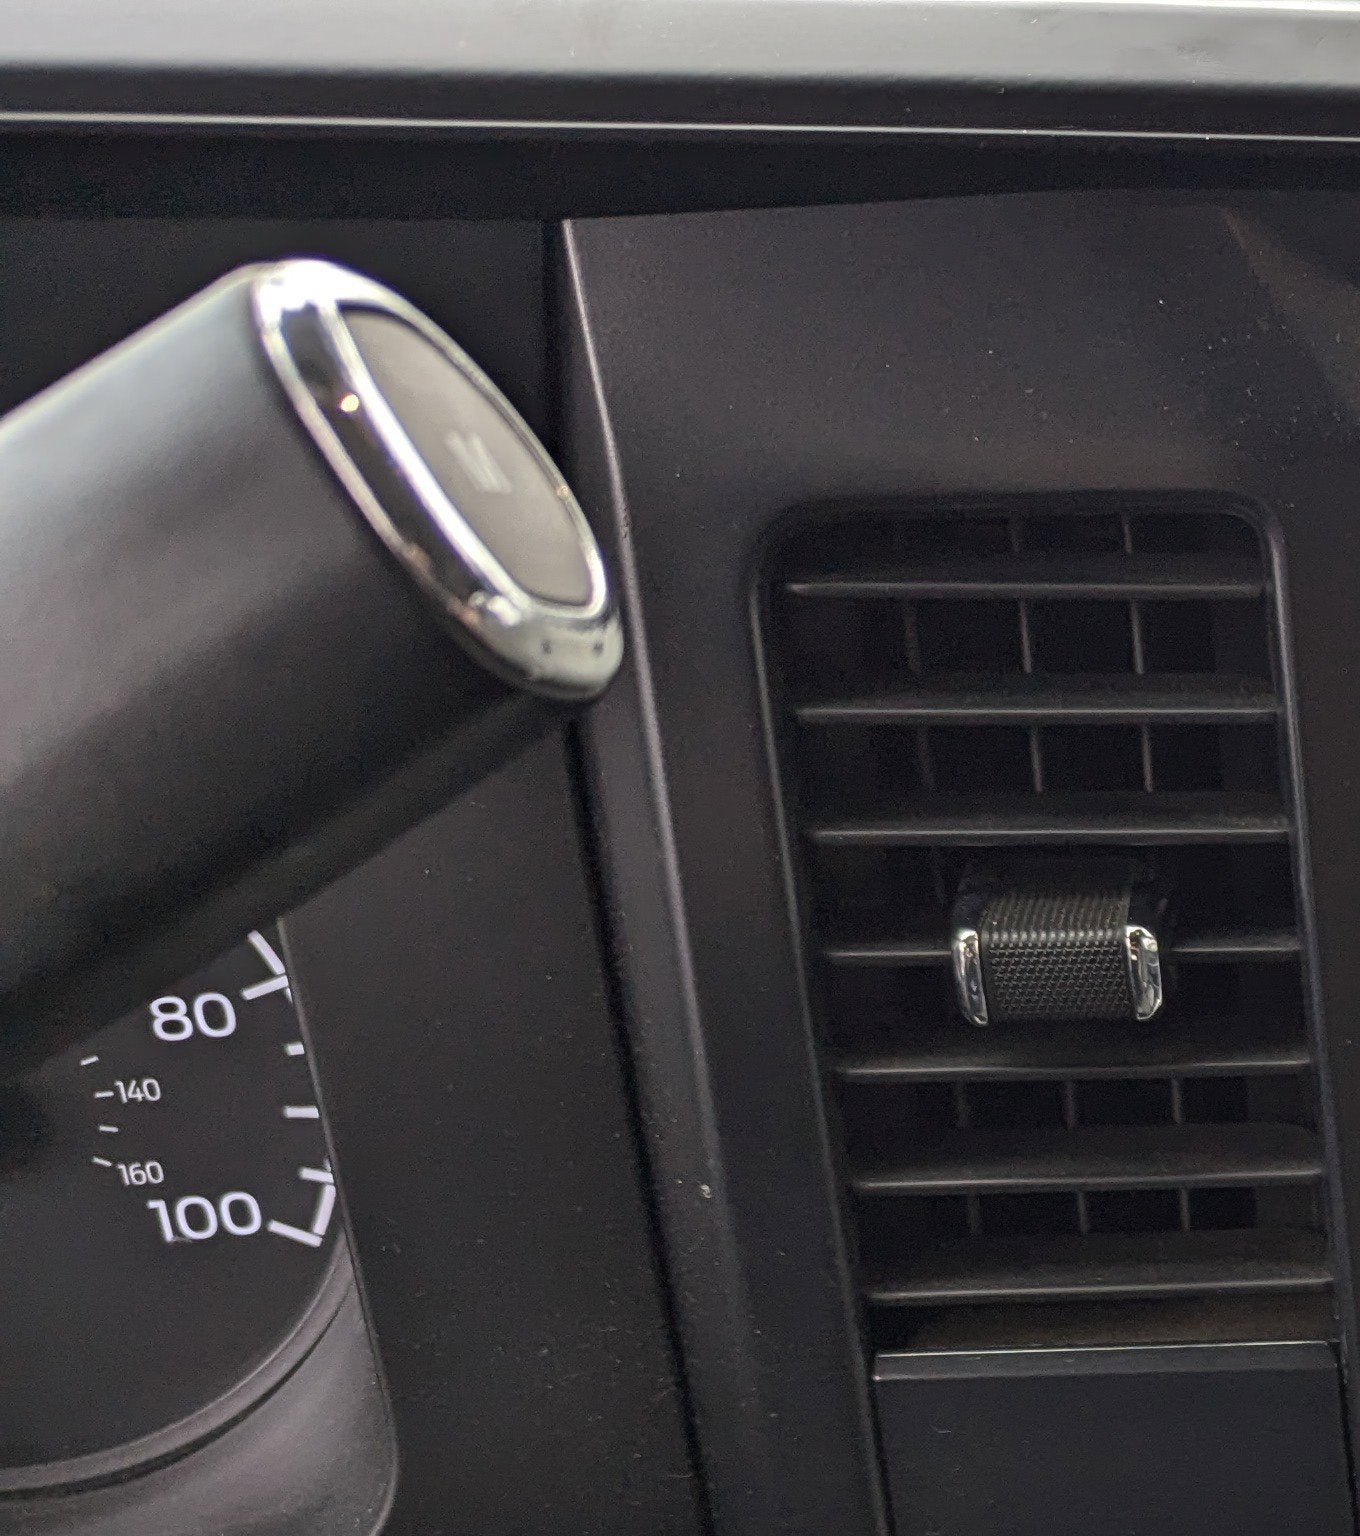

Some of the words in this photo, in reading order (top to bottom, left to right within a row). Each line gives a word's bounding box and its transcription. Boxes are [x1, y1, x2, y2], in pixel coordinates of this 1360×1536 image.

[148, 991, 238, 1042] 80
[114, 1077, 162, 1104] 140
[117, 1160, 165, 1187] 160
[146, 1190, 263, 1244] 100
